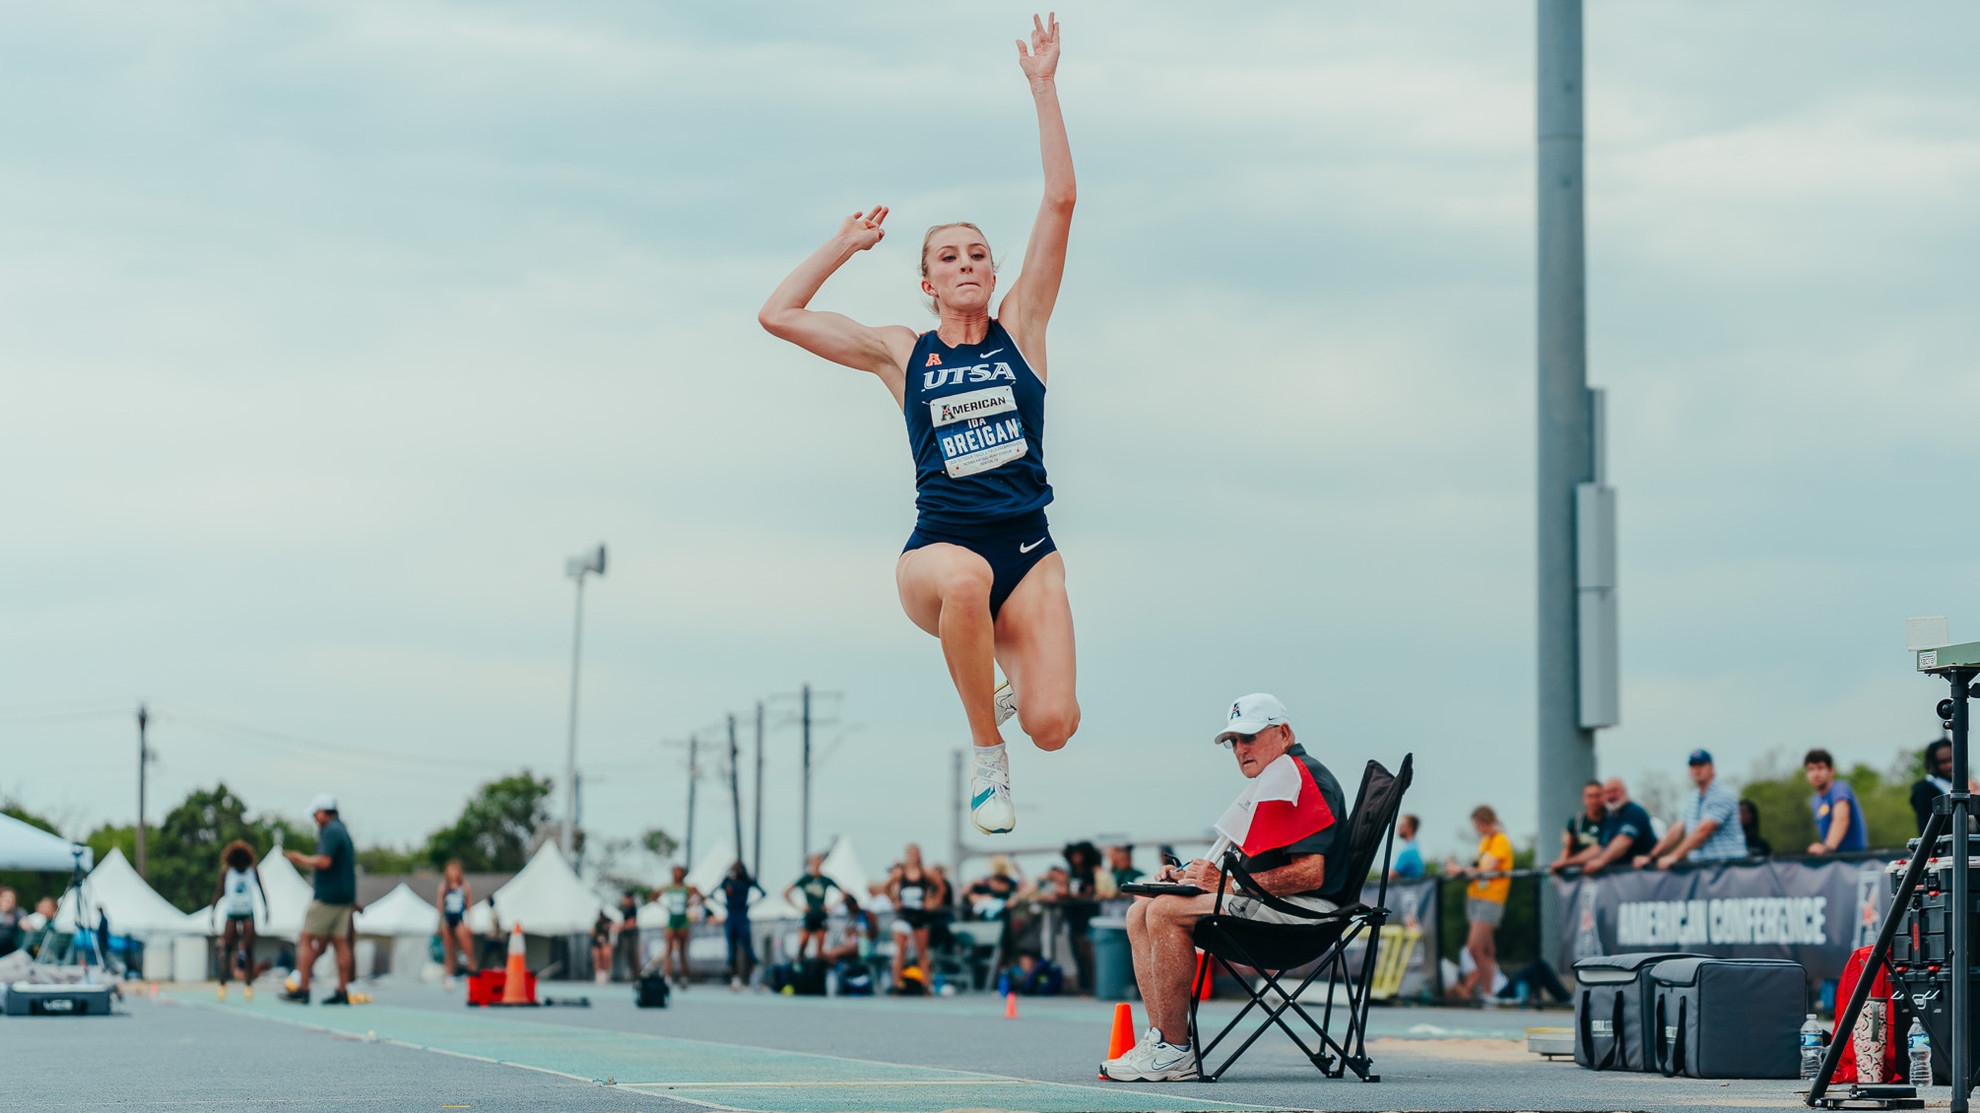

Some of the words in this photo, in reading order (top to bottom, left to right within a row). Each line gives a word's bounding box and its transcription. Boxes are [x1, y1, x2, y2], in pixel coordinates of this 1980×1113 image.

[923, 362, 1017, 390] UTSA
[942, 418, 1020, 458] BREIGAN
[967, 418, 987, 430] IDA
[1617, 900, 1709, 946] AMERICAN
[1709, 896, 1827, 945] CONFERENCE
